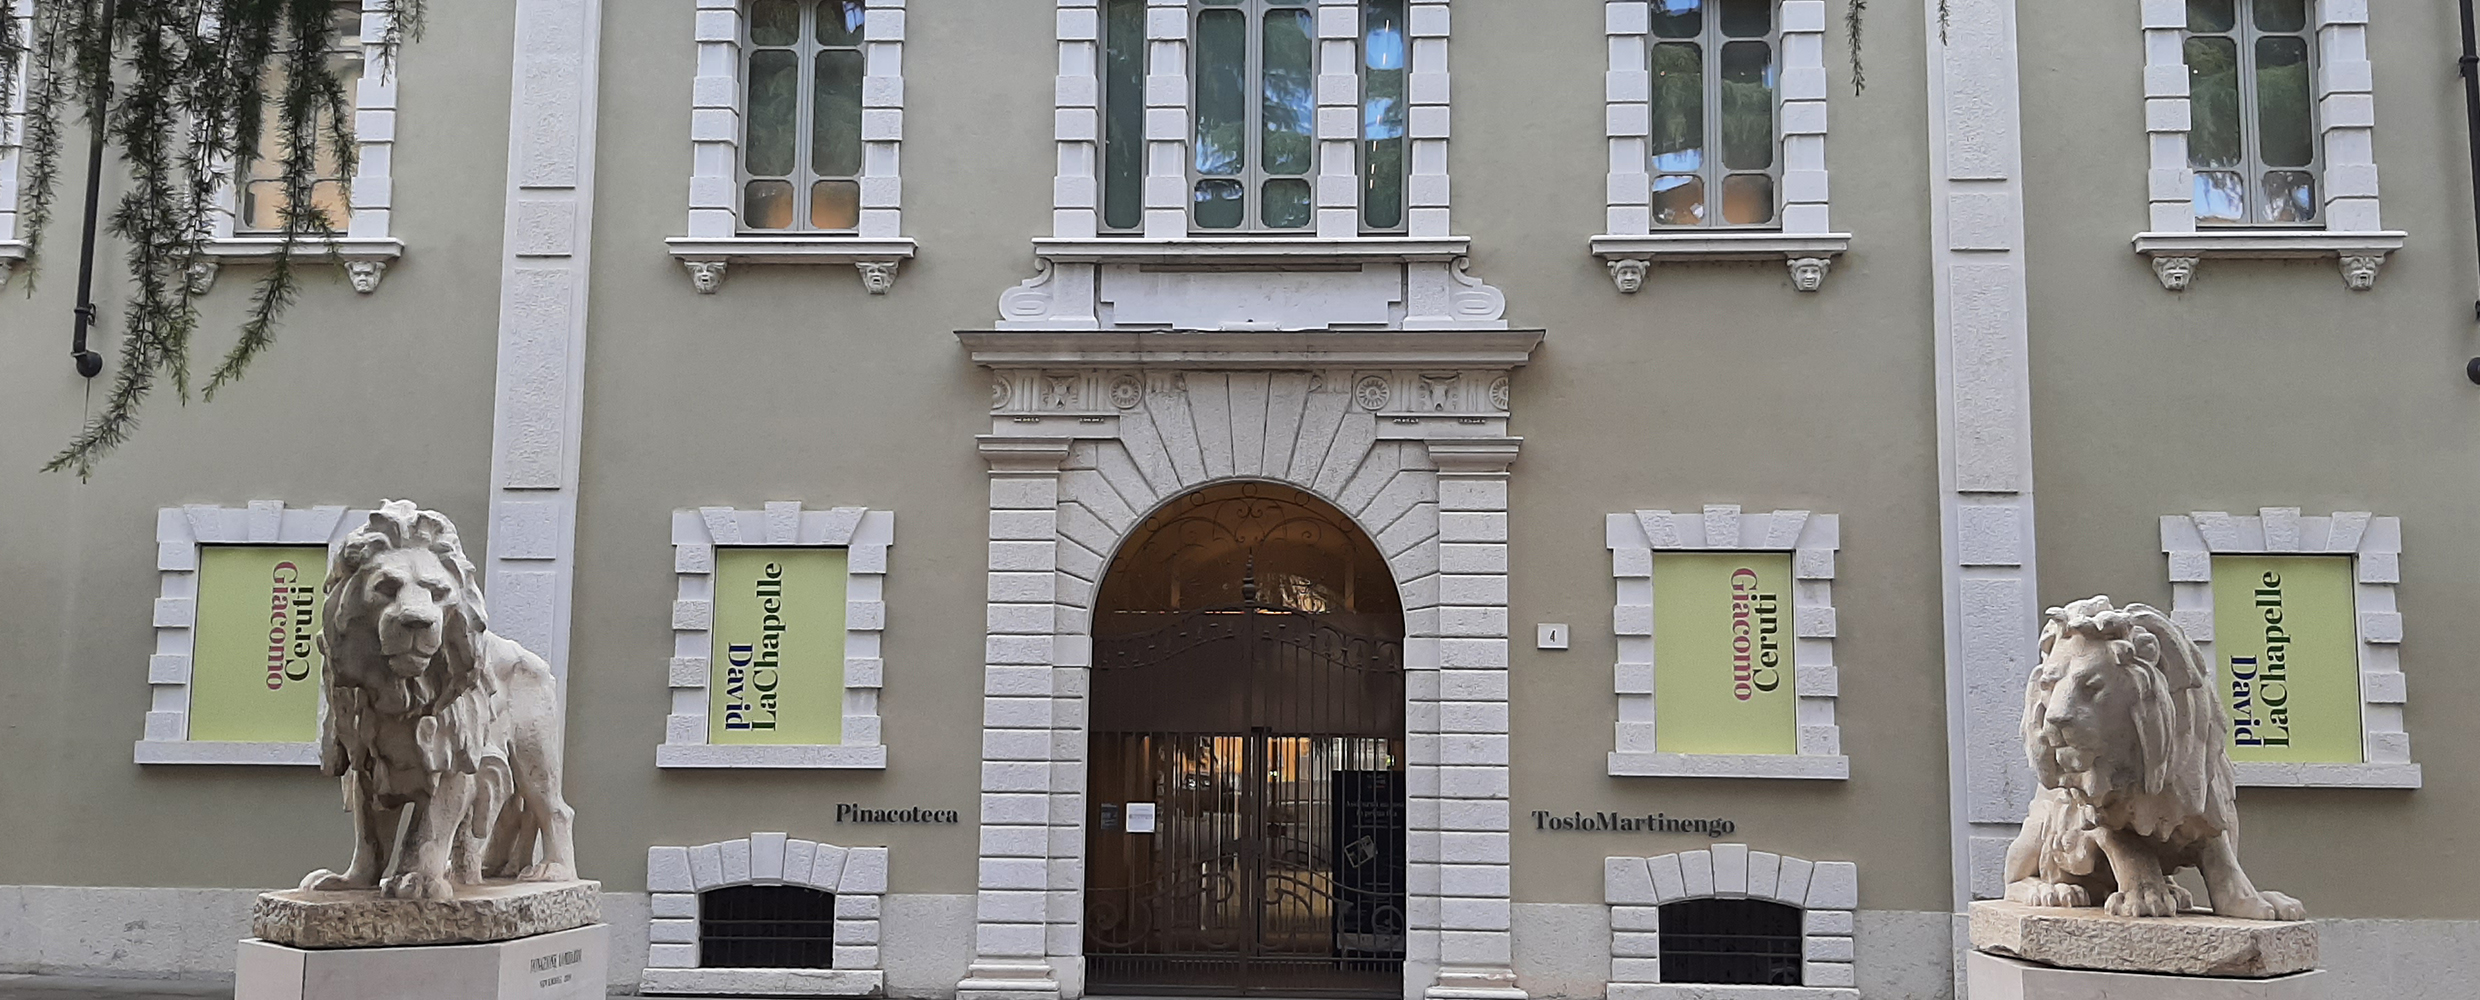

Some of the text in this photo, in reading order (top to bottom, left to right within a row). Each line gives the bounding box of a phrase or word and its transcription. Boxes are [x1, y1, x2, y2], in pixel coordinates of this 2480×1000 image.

[266, 561, 299, 690] Giacomo
[285, 586, 315, 682] Ceruti
[751, 562, 787, 732] LaChapelle
[1549, 629, 1556, 643] 4
[1730, 567, 1758, 702] Giacomo
[1751, 594, 1780, 693] Ceruti
[2254, 570, 2292, 748] LaChapelle
[726, 642, 754, 731] David
[2230, 655, 2263, 746] David
[835, 802, 959, 824] Pinacoteca
[1531, 810, 1736, 838] TosioMartinengo
